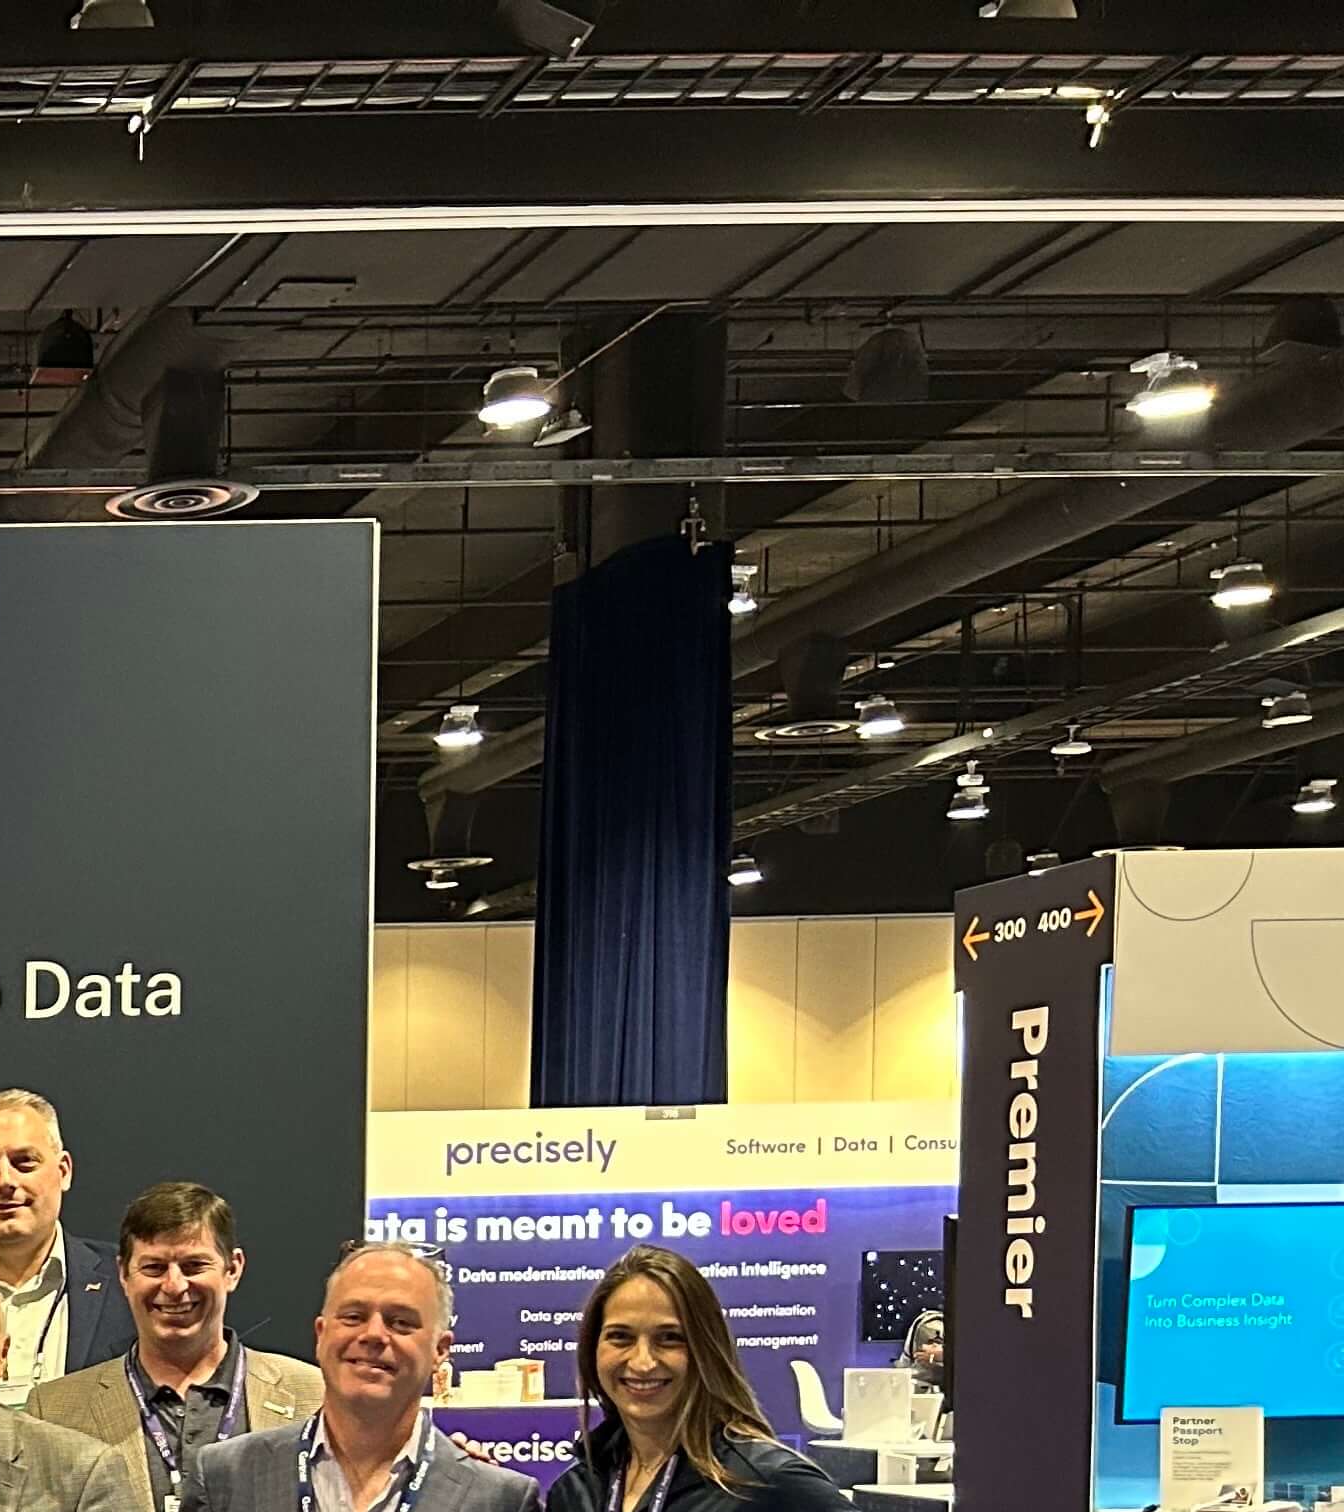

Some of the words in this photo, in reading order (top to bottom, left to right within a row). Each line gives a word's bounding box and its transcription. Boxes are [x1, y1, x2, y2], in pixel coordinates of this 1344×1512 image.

[993, 917, 1027, 943] 300
[1037, 907, 1073, 933] 400
[24, 958, 183, 1018] Data
[446, 1128, 617, 1176] precisely
[726, 1137, 806, 1156] Software
[833, 1136, 878, 1153] Data
[1005, 1006, 1050, 1319] Premier
[437, 1207, 467, 1242] is
[477, 1208, 603, 1242] meant
[611, 1207, 653, 1238] to
[662, 1202, 712, 1236] be
[720, 1199, 827, 1236] loved
[459, 1267, 497, 1283] Data
[499, 1265, 605, 1282] modernization
[741, 1260, 827, 1279] intelligence
[1146, 1294, 1177, 1308] Turn
[1181, 1293, 1247, 1310] Complex
[1251, 1292, 1285, 1306] Data
[520, 1310, 552, 1323] Data
[729, 1304, 816, 1318] modernization
[1145, 1315, 1173, 1328] Into
[1177, 1314, 1240, 1327] Business
[1244, 1313, 1293, 1329] Insight
[519, 1338, 562, 1353] Spatial
[736, 1333, 819, 1349] management
[1173, 1417, 1216, 1426] Partner
[1173, 1426, 1224, 1437] Passport
[1173, 1436, 1200, 1446] Stop
